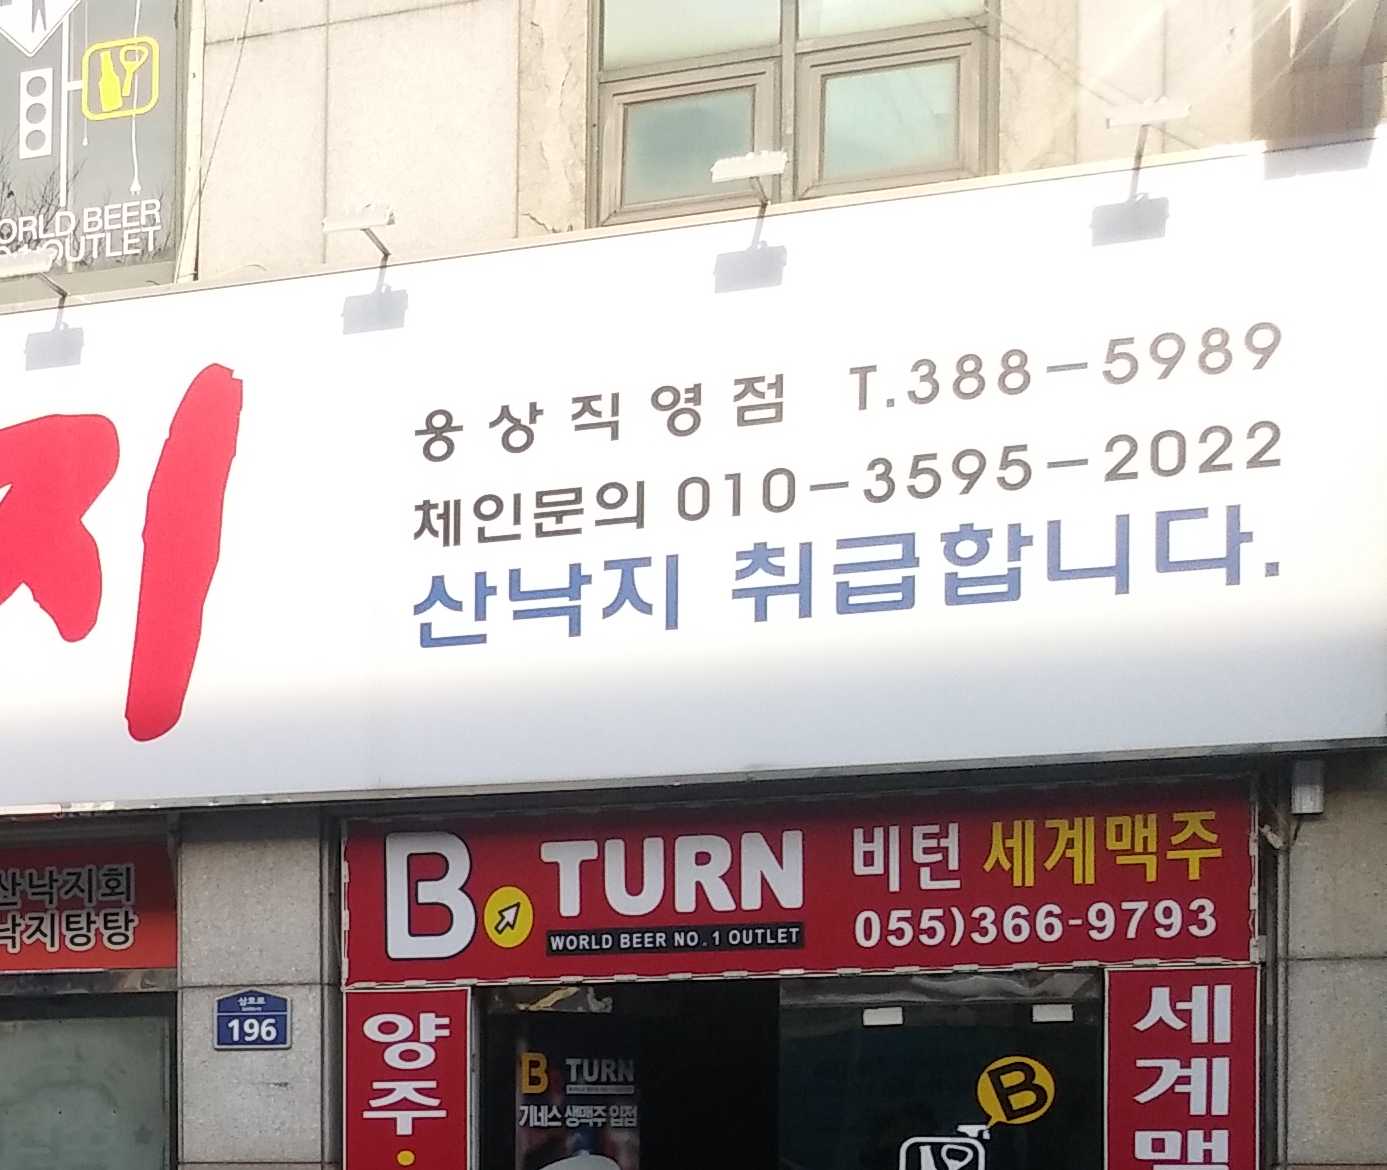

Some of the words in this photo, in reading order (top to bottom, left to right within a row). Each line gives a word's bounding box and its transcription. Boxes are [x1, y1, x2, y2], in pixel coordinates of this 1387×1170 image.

[83, 199, 161, 232] BEER
[414, 480, 646, 549] 체인문의
[677, 420, 1284, 523] 010-3595-2022
[413, 552, 680, 650] 산낙지
[731, 503, 1282, 624] 취급합니다.
[851, 823, 964, 895] 비턴
[983, 811, 1223, 890] 세계맥주
[383, 829, 478, 963] B
[540, 829, 805, 920] TURN
[549, 933, 614, 952] WORLD
[619, 930, 668, 949] BEER
[728, 926, 801, 946] OUTLET
[855, 898, 1218, 949] 055)366-9793
[228, 1018, 277, 1042] 196
[565, 1058, 635, 1082] TURN
[519, 1105, 562, 1127] 기네스
[564, 1105, 607, 1127] 생맥주
[609, 1105, 638, 1127] 입점
